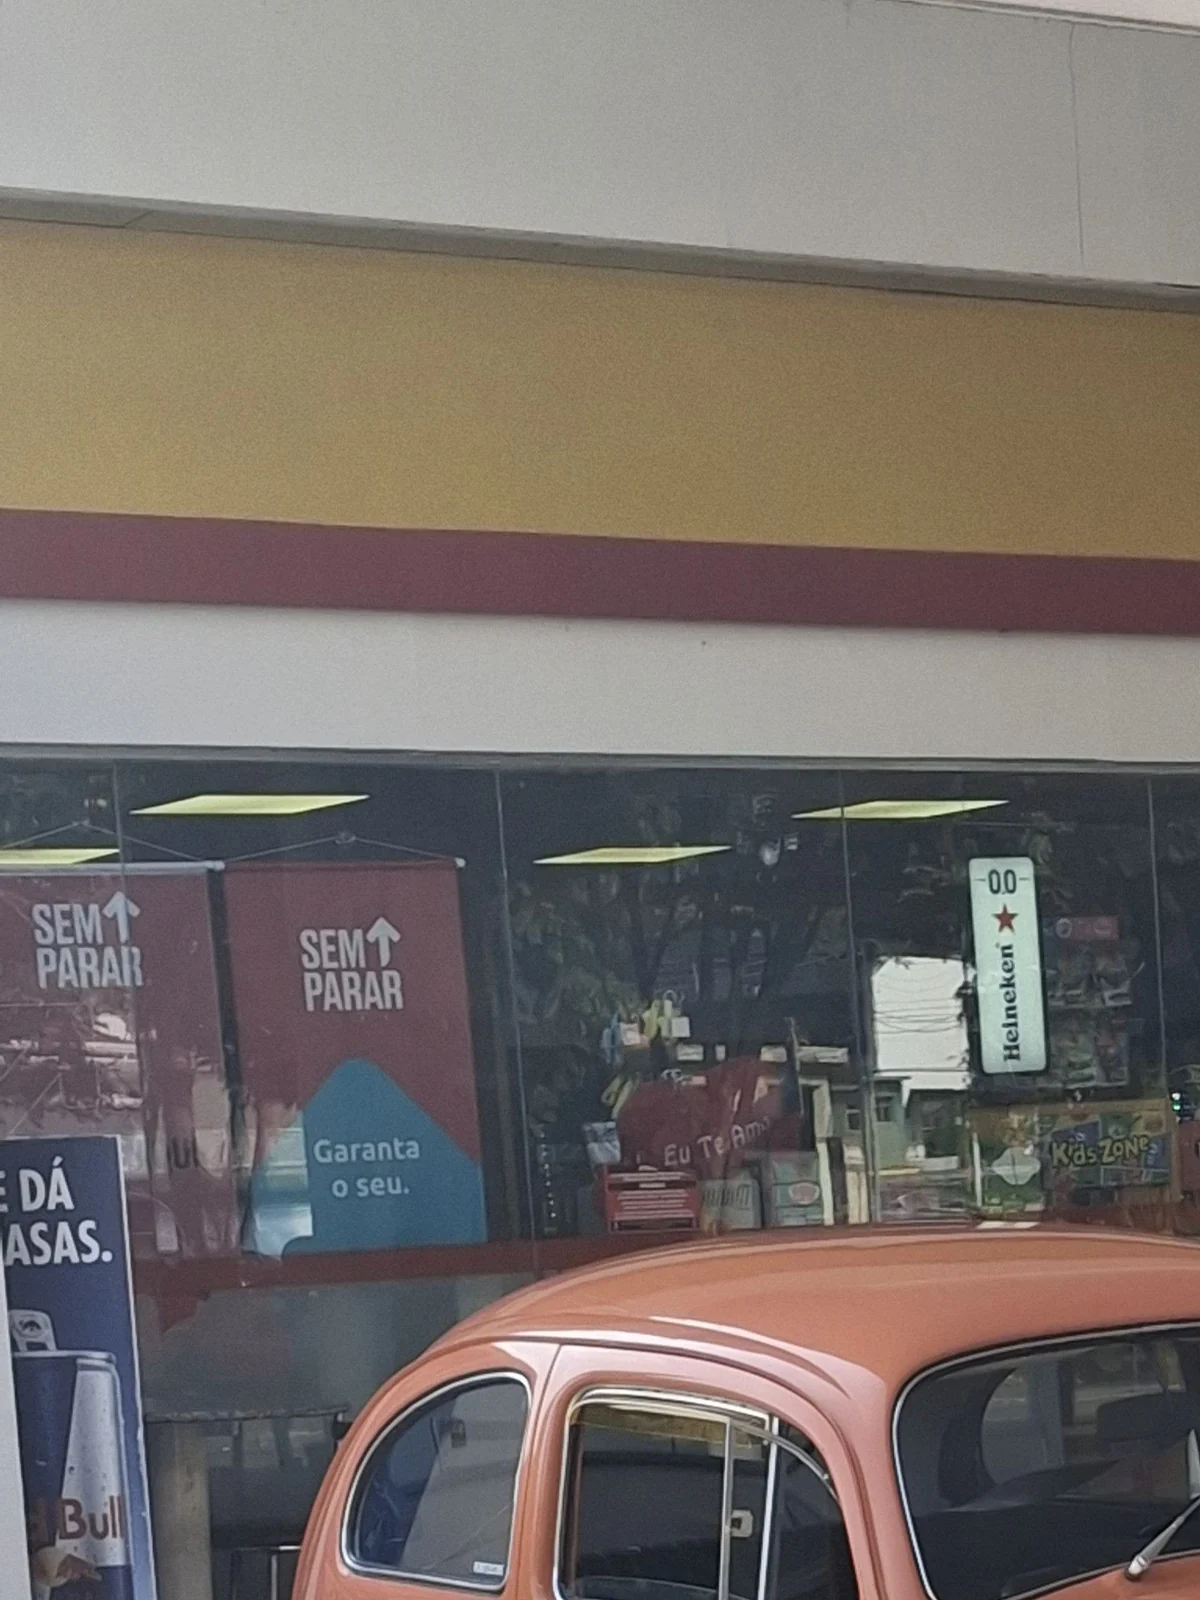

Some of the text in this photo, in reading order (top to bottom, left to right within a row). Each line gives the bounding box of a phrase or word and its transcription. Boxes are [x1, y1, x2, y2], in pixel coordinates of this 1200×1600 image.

[32, 903, 102, 946] SEM
[36, 945, 144, 989] PARAR
[300, 929, 367, 970] SEM
[303, 971, 404, 1012] PARAR
[1001, 942, 1021, 1062] Heineken
[313, 1138, 421, 1166] Garanta
[1052, 1137, 1098, 1166] Kids
[19, 1156, 75, 1213] DÁ
[331, 1176, 410, 1198] o seu.
[4, 1219, 113, 1267] ASAS.
[57, 1495, 124, 1540] Bull
